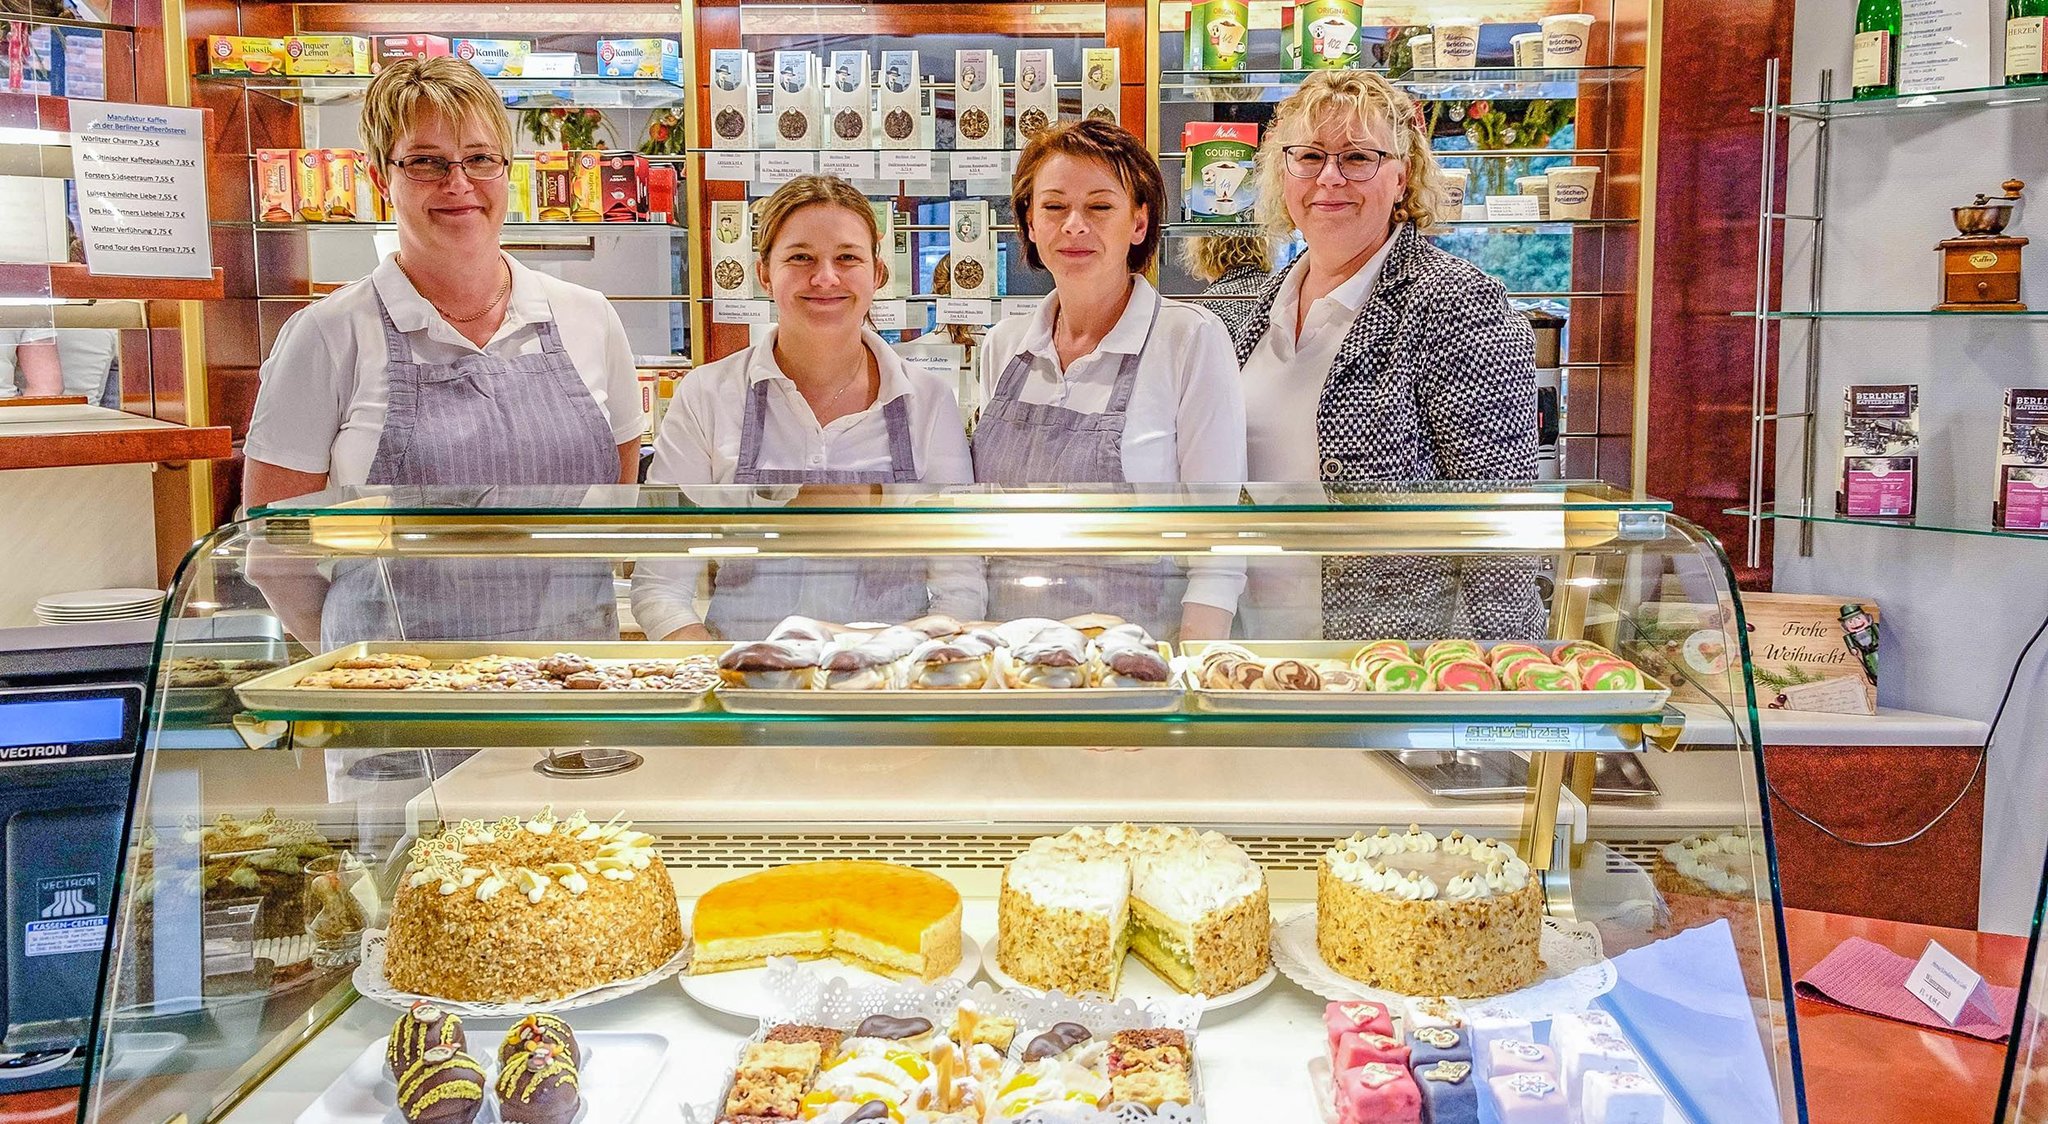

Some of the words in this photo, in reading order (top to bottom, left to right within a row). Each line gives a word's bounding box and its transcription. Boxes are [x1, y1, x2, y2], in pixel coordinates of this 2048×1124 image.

[242, 45, 273, 53] Klassik
[302, 41, 329, 49] Ingwer
[476, 48, 510, 57] Kamille
[615, 48, 644, 57] Kamille
[106, 113, 146, 122] Manufaktur
[112, 137, 139, 145] Charme
[1205, 148, 1246, 157] GOURMET
[1782, 621, 1828, 638] Frohe
[1763, 643, 1847, 665] Weihnacht
[1465, 726, 1570, 740] SCHWEITZER
[0, 744, 67, 759] VECTRON
[41, 878, 96, 890] VECTRON
[32, 918, 105, 932] KASSEN-CENTER
